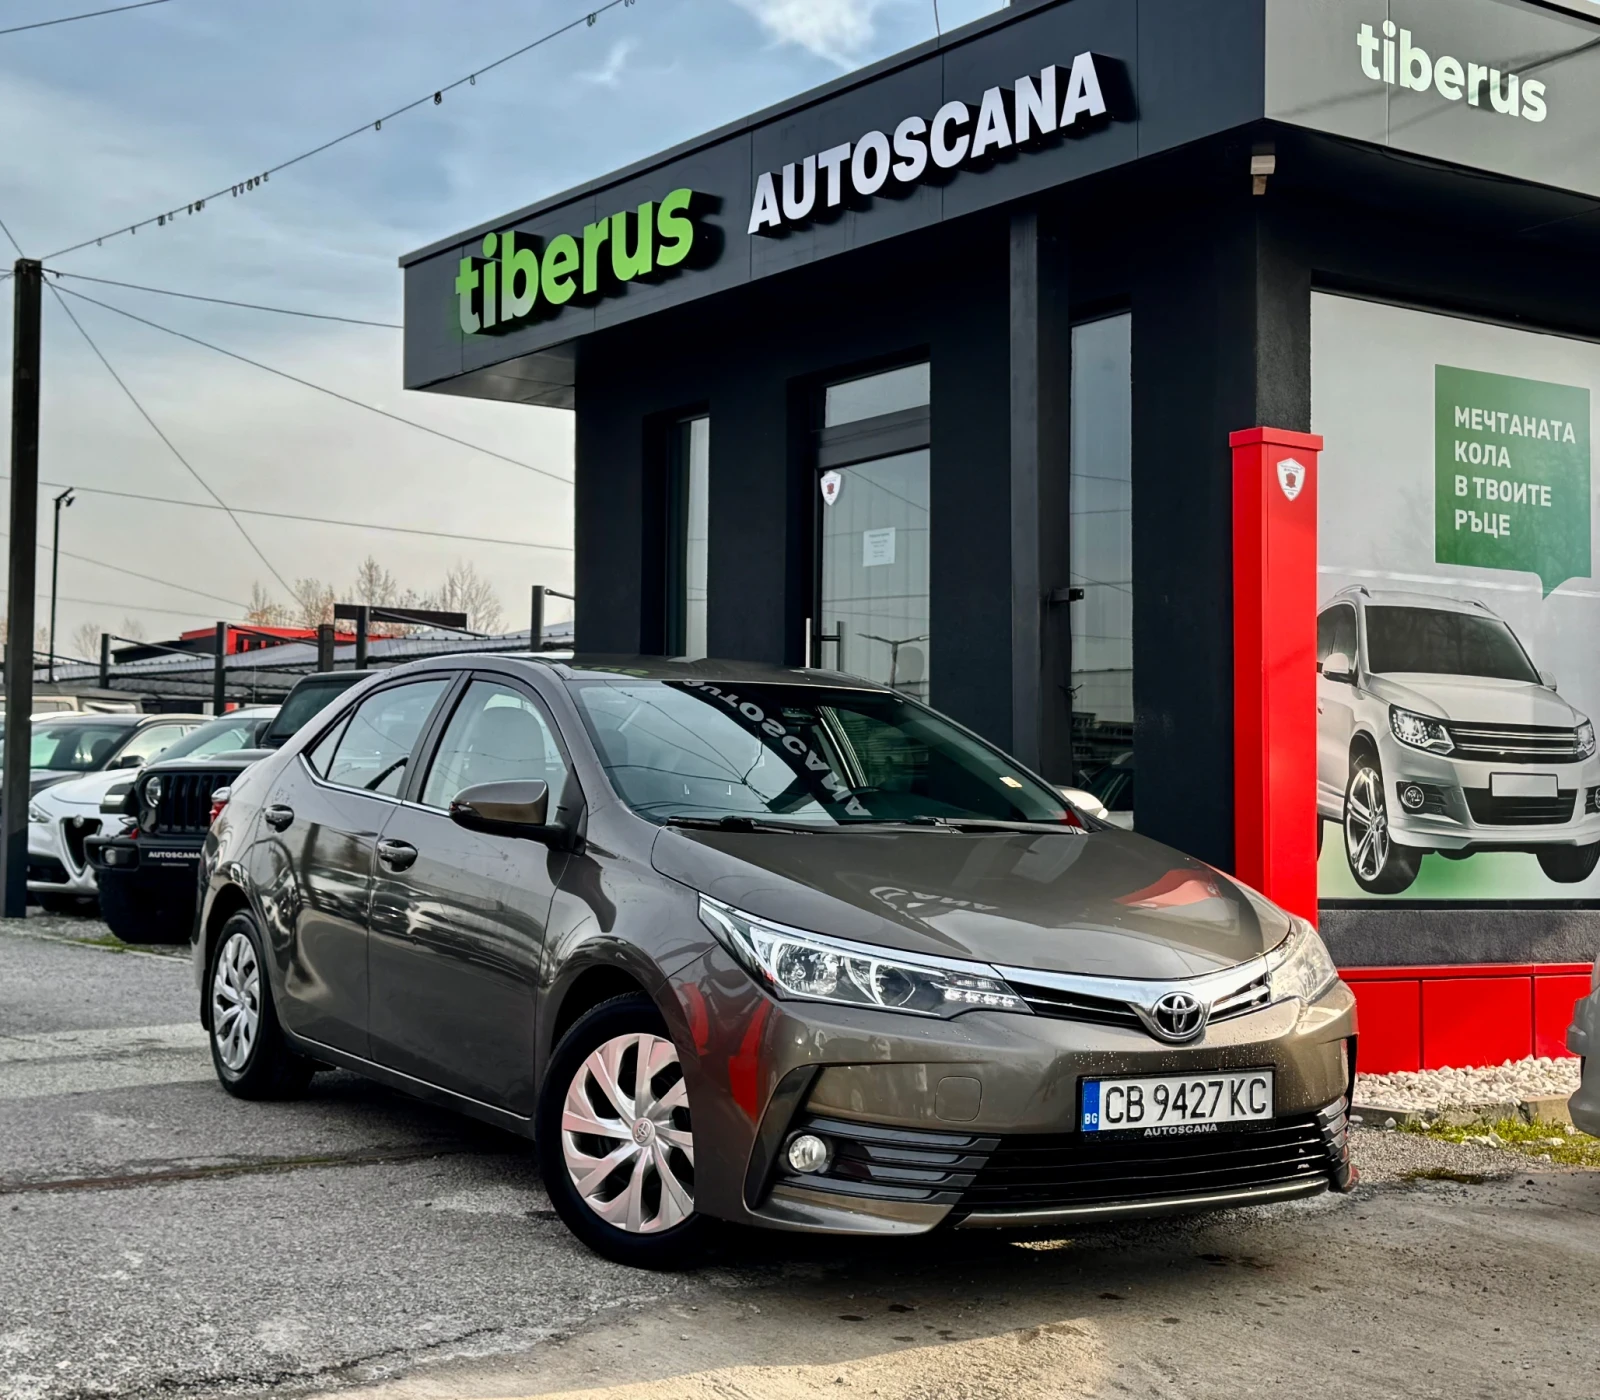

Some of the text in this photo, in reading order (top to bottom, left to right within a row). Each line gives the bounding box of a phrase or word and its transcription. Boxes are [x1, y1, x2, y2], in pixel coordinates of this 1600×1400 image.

[1356, 20, 1547, 122] tiberus
[747, 51, 1106, 234] AUTOSCANA
[455, 187, 694, 335] tiberus
[1454, 405, 1576, 444] МЕЧТАНАТА
[1454, 440, 1511, 468] КОЛА
[1454, 474, 1552, 507] В ТВОИТЕ
[1454, 509, 1511, 538] РЪЦЕ
[1084, 1112, 1098, 1125] BG
[1105, 1078, 1267, 1124] CB 9427 KC
[1143, 1123, 1218, 1137] AUTOSCANA
